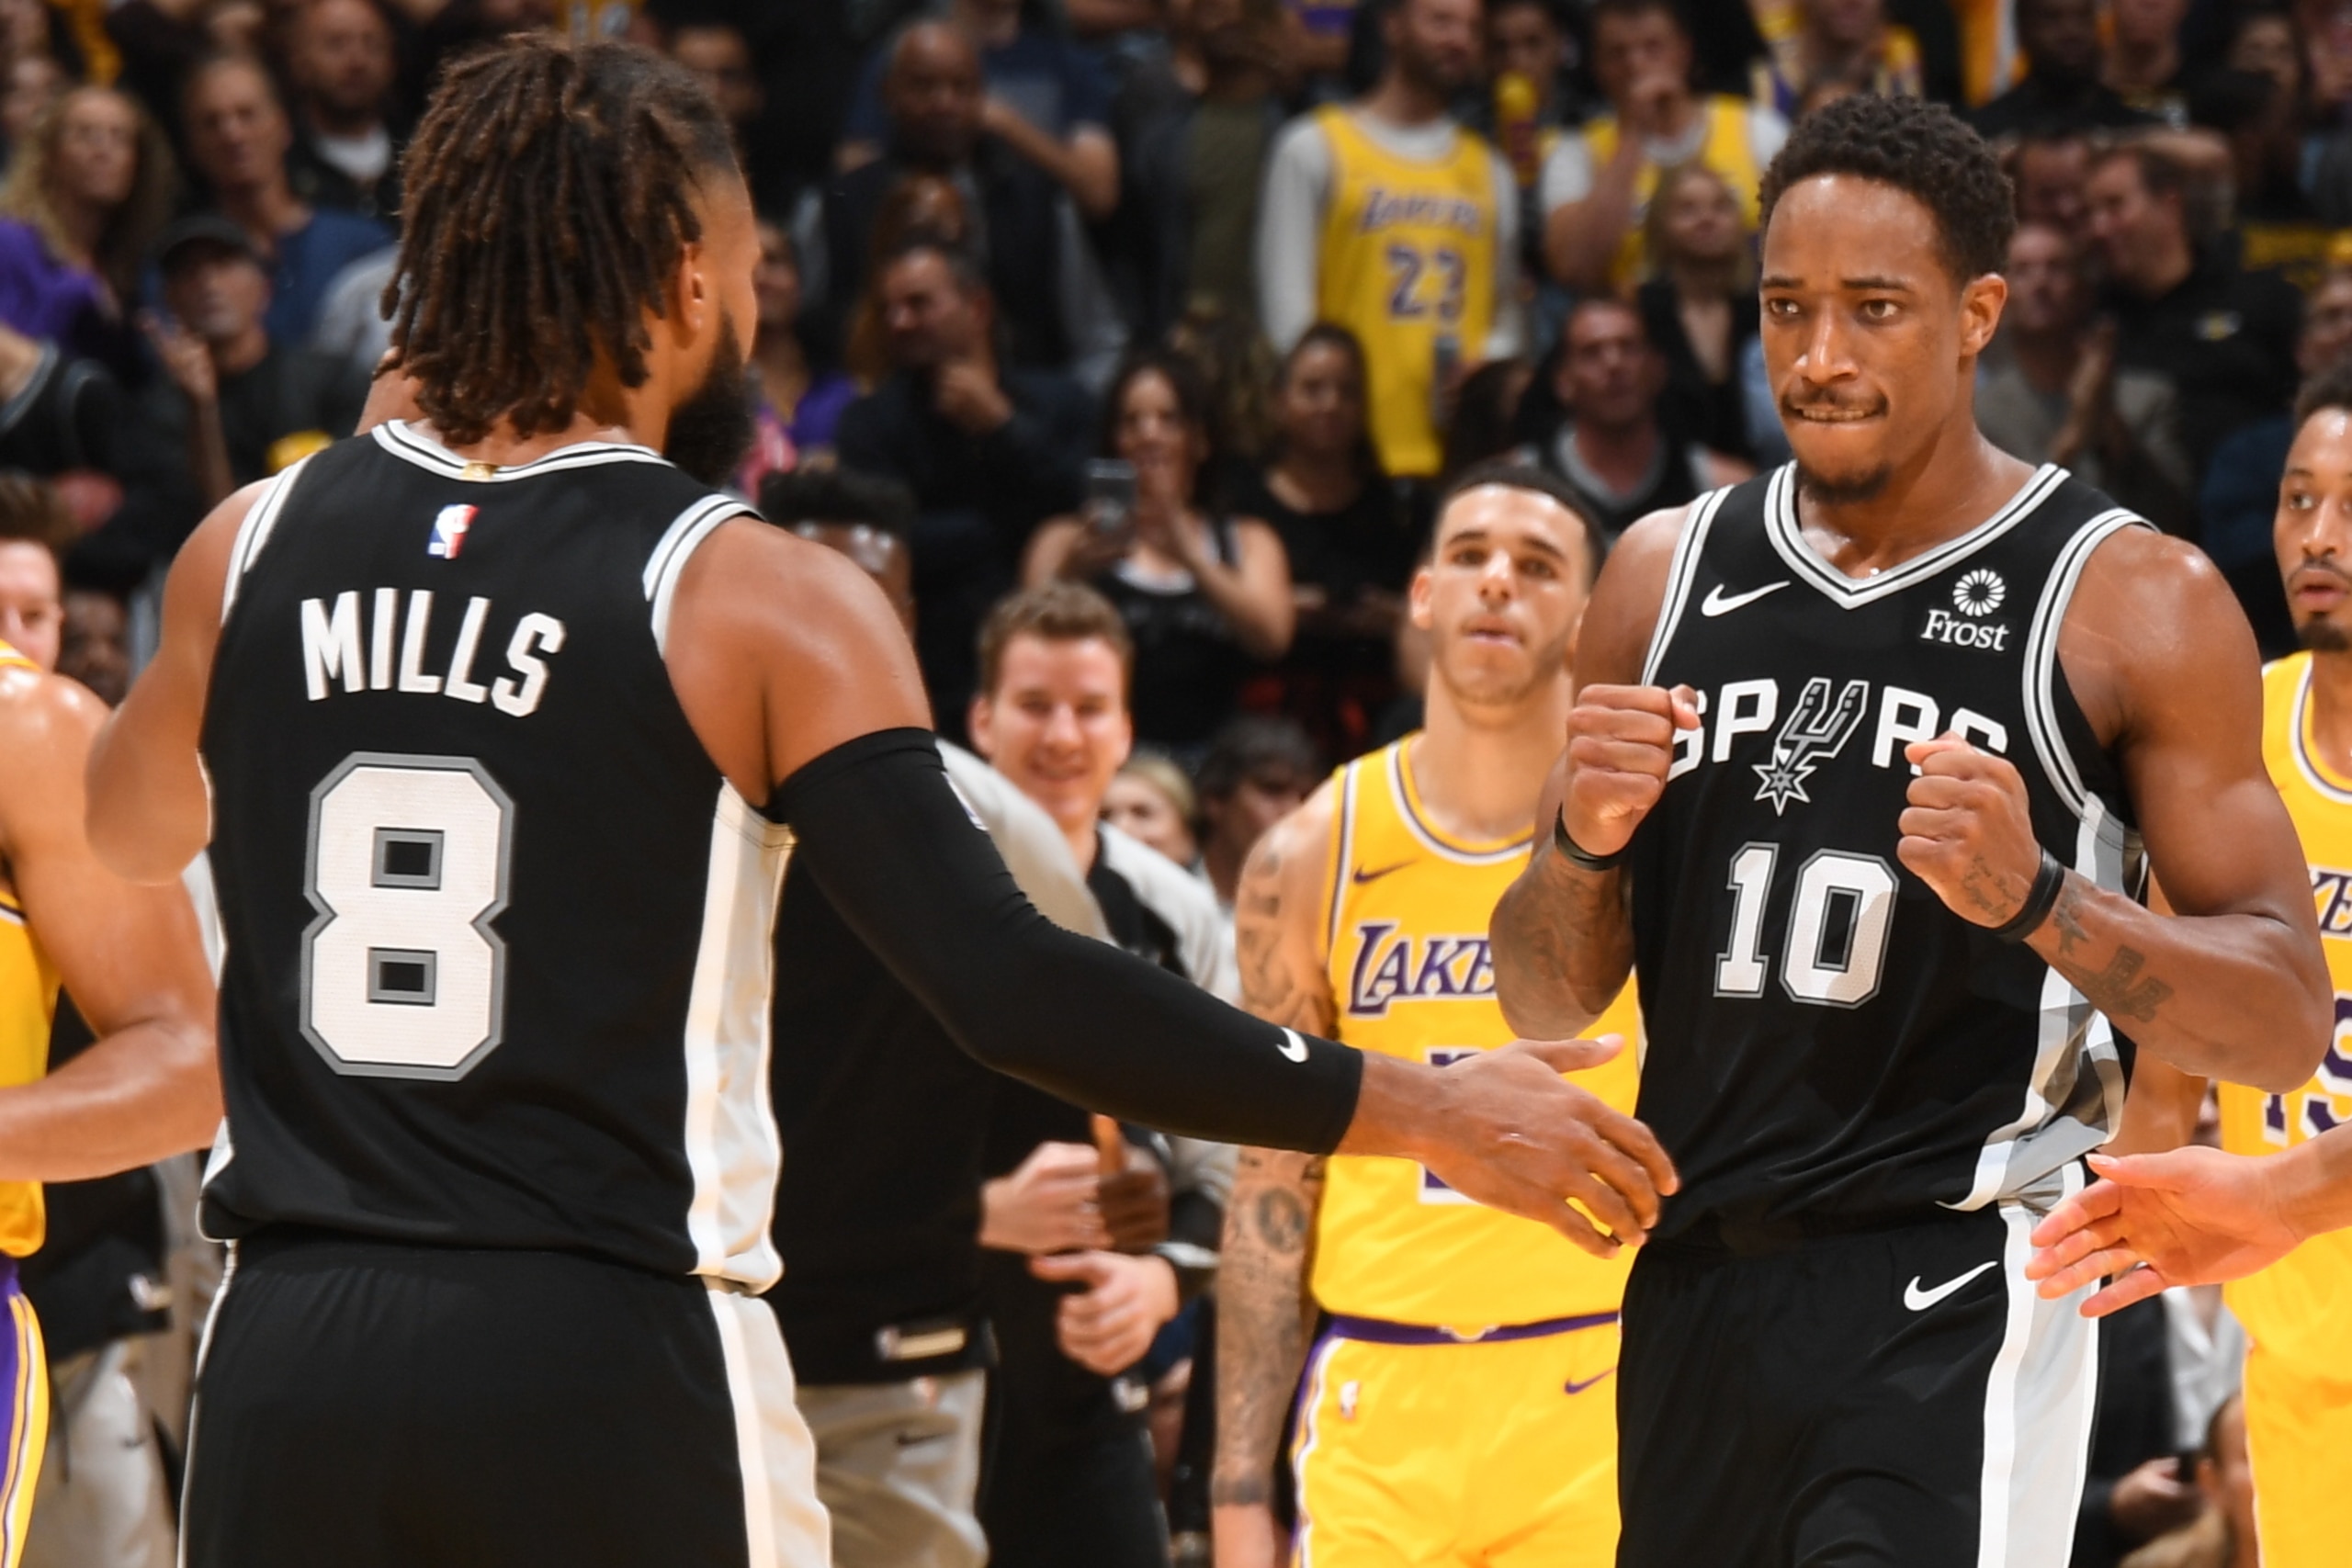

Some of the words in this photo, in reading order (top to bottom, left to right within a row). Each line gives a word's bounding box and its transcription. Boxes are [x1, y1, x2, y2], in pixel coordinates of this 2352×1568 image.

[1386, 244, 1468, 323] 23
[300, 587, 567, 717] MILLS
[1920, 609, 2010, 651] Frost
[299, 750, 515, 1082] 8
[1345, 919, 1498, 1019] LAKE
[1713, 840, 1900, 1010] 10
